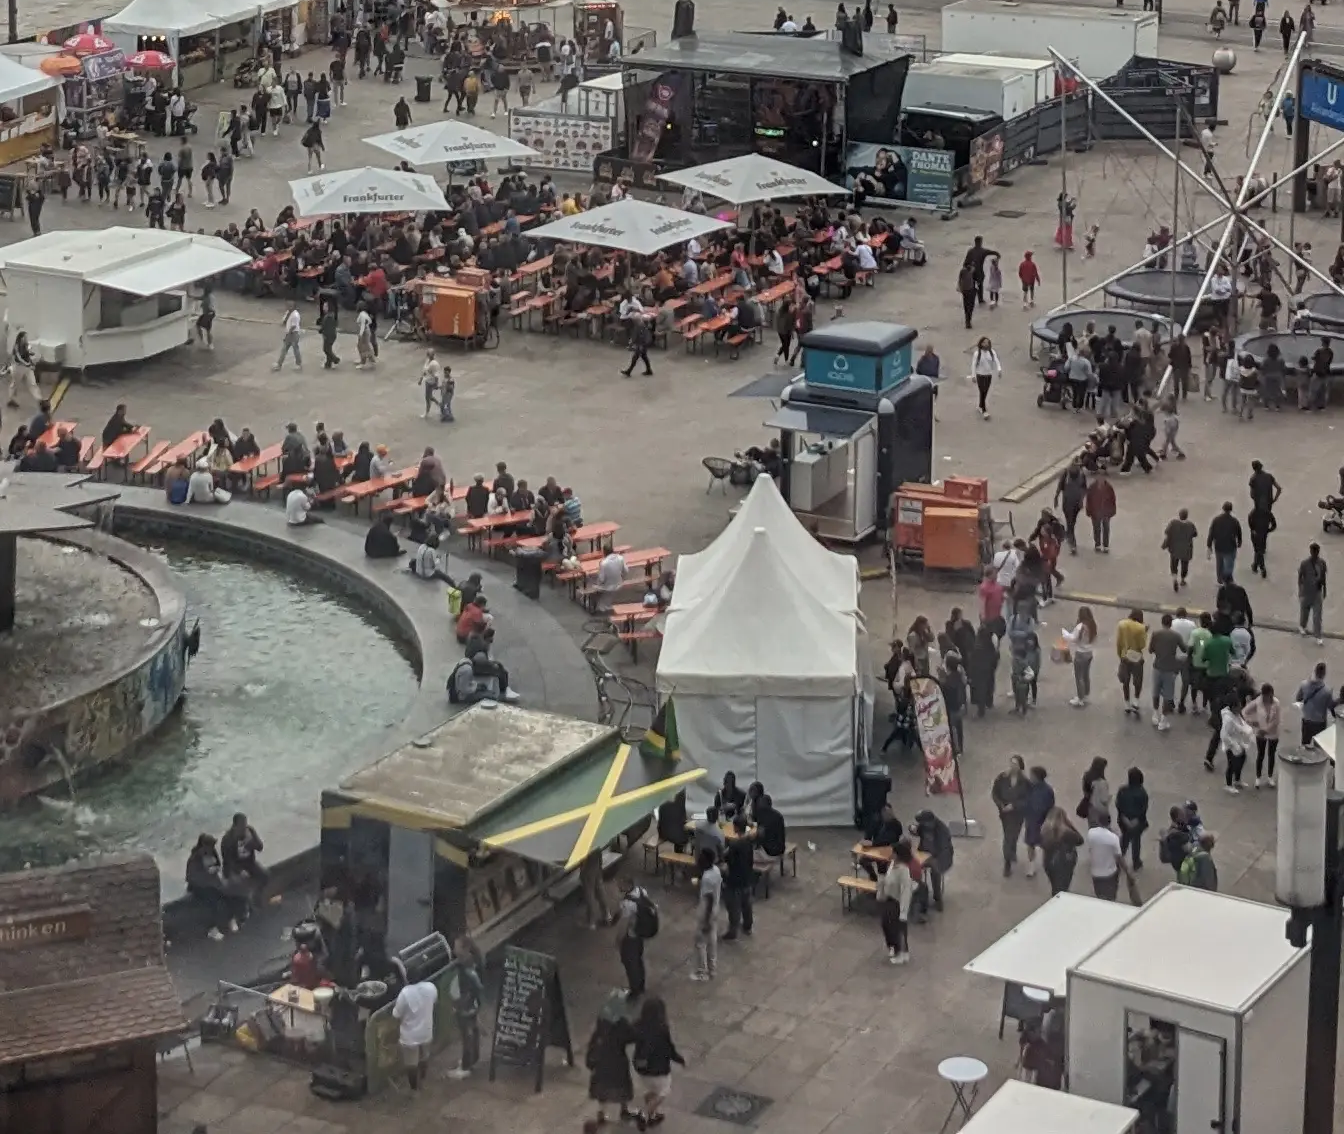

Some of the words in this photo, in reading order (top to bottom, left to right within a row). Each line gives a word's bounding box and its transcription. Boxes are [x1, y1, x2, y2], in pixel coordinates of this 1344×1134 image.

[1327, 82, 1338, 105] U
[443, 141, 497, 153] Frankfurter
[912, 151, 950, 164] DANTE
[343, 192, 405, 204] Frankfurter
